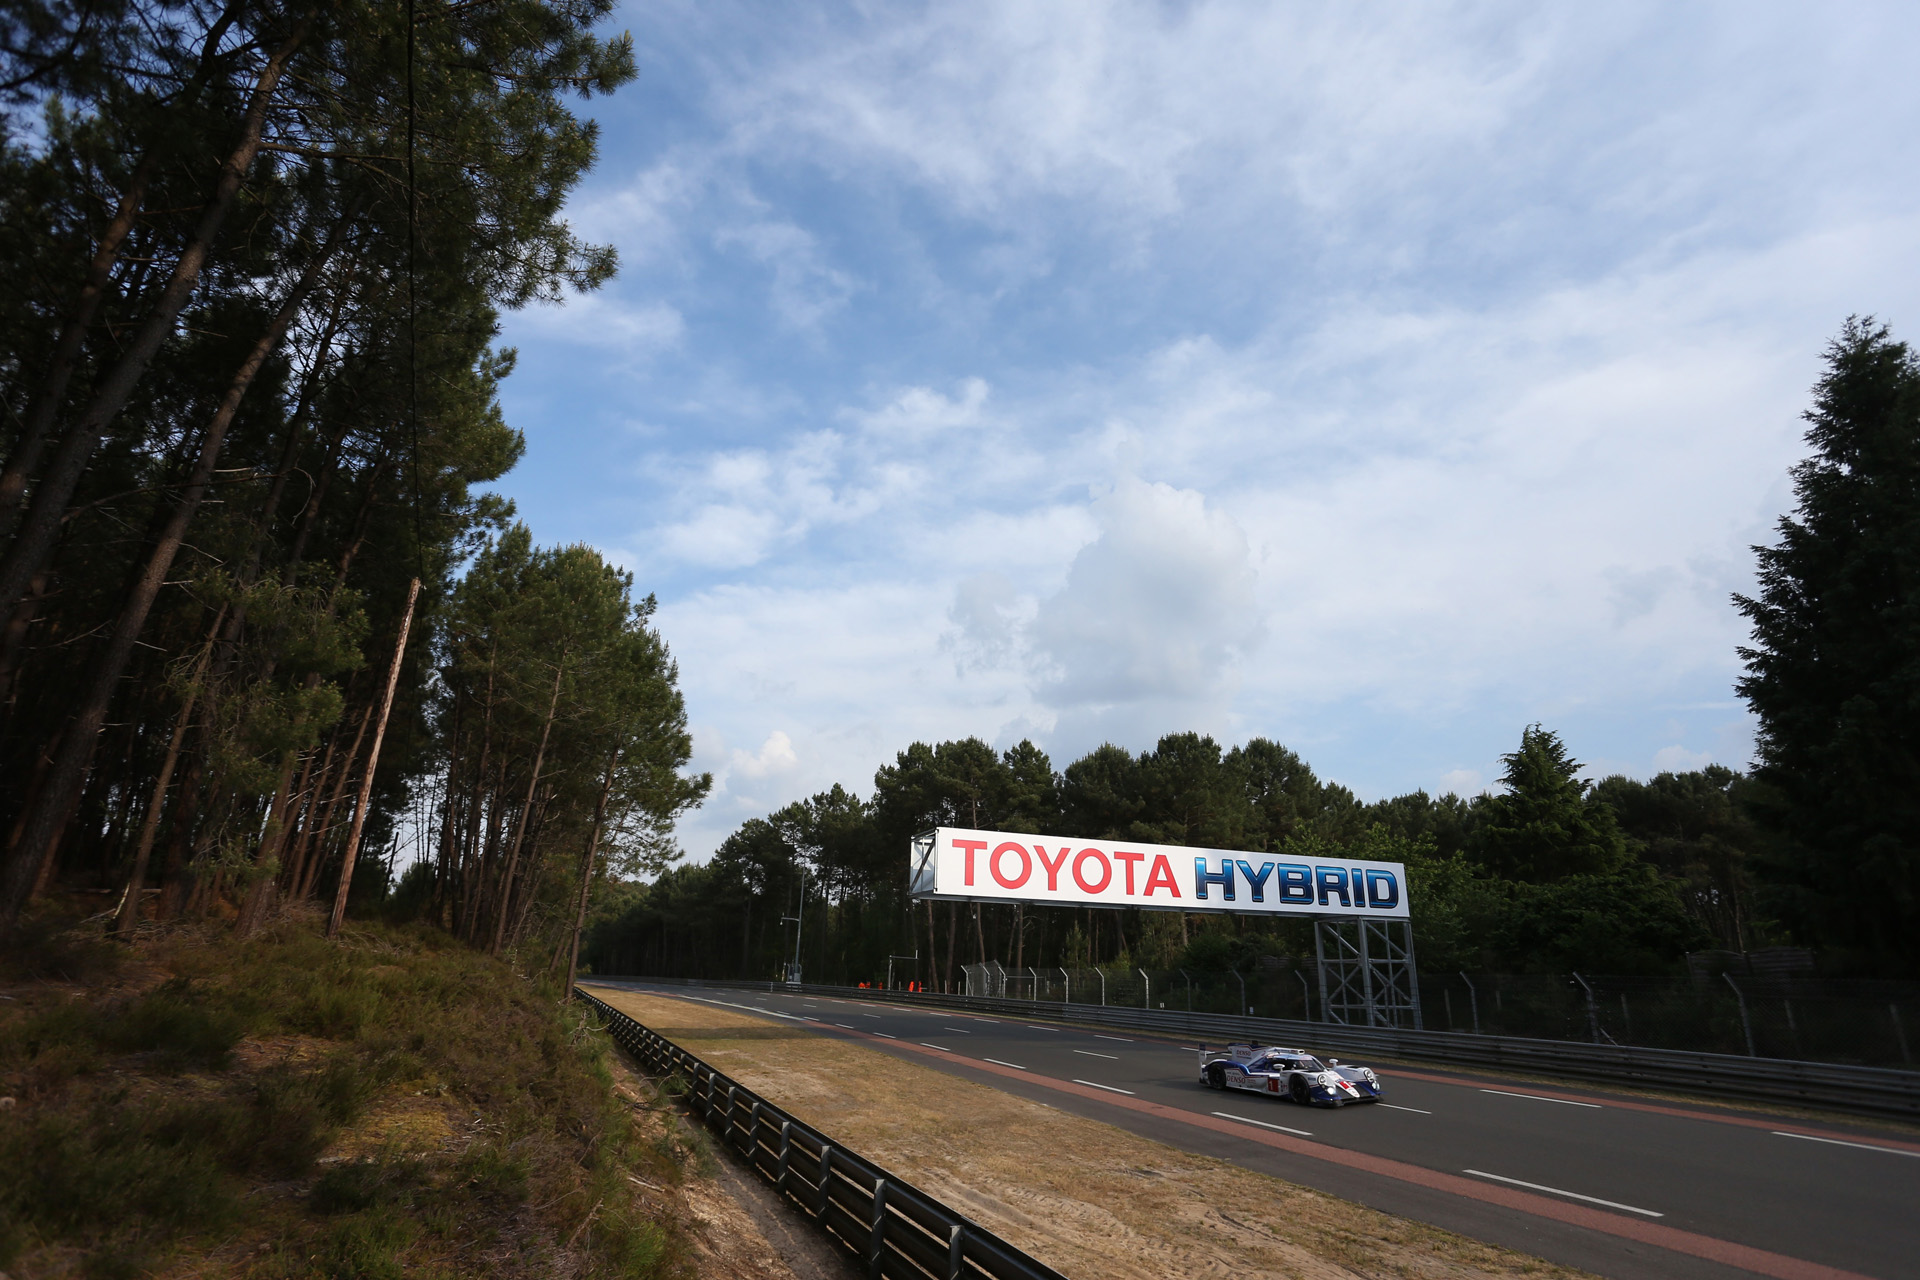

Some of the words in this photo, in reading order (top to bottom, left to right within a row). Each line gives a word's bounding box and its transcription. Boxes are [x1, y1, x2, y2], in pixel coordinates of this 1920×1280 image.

[952, 839, 1182, 898] TOYOTA
[1195, 857, 1399, 909] HYBRID
[1227, 1075, 1246, 1083] DENSO
